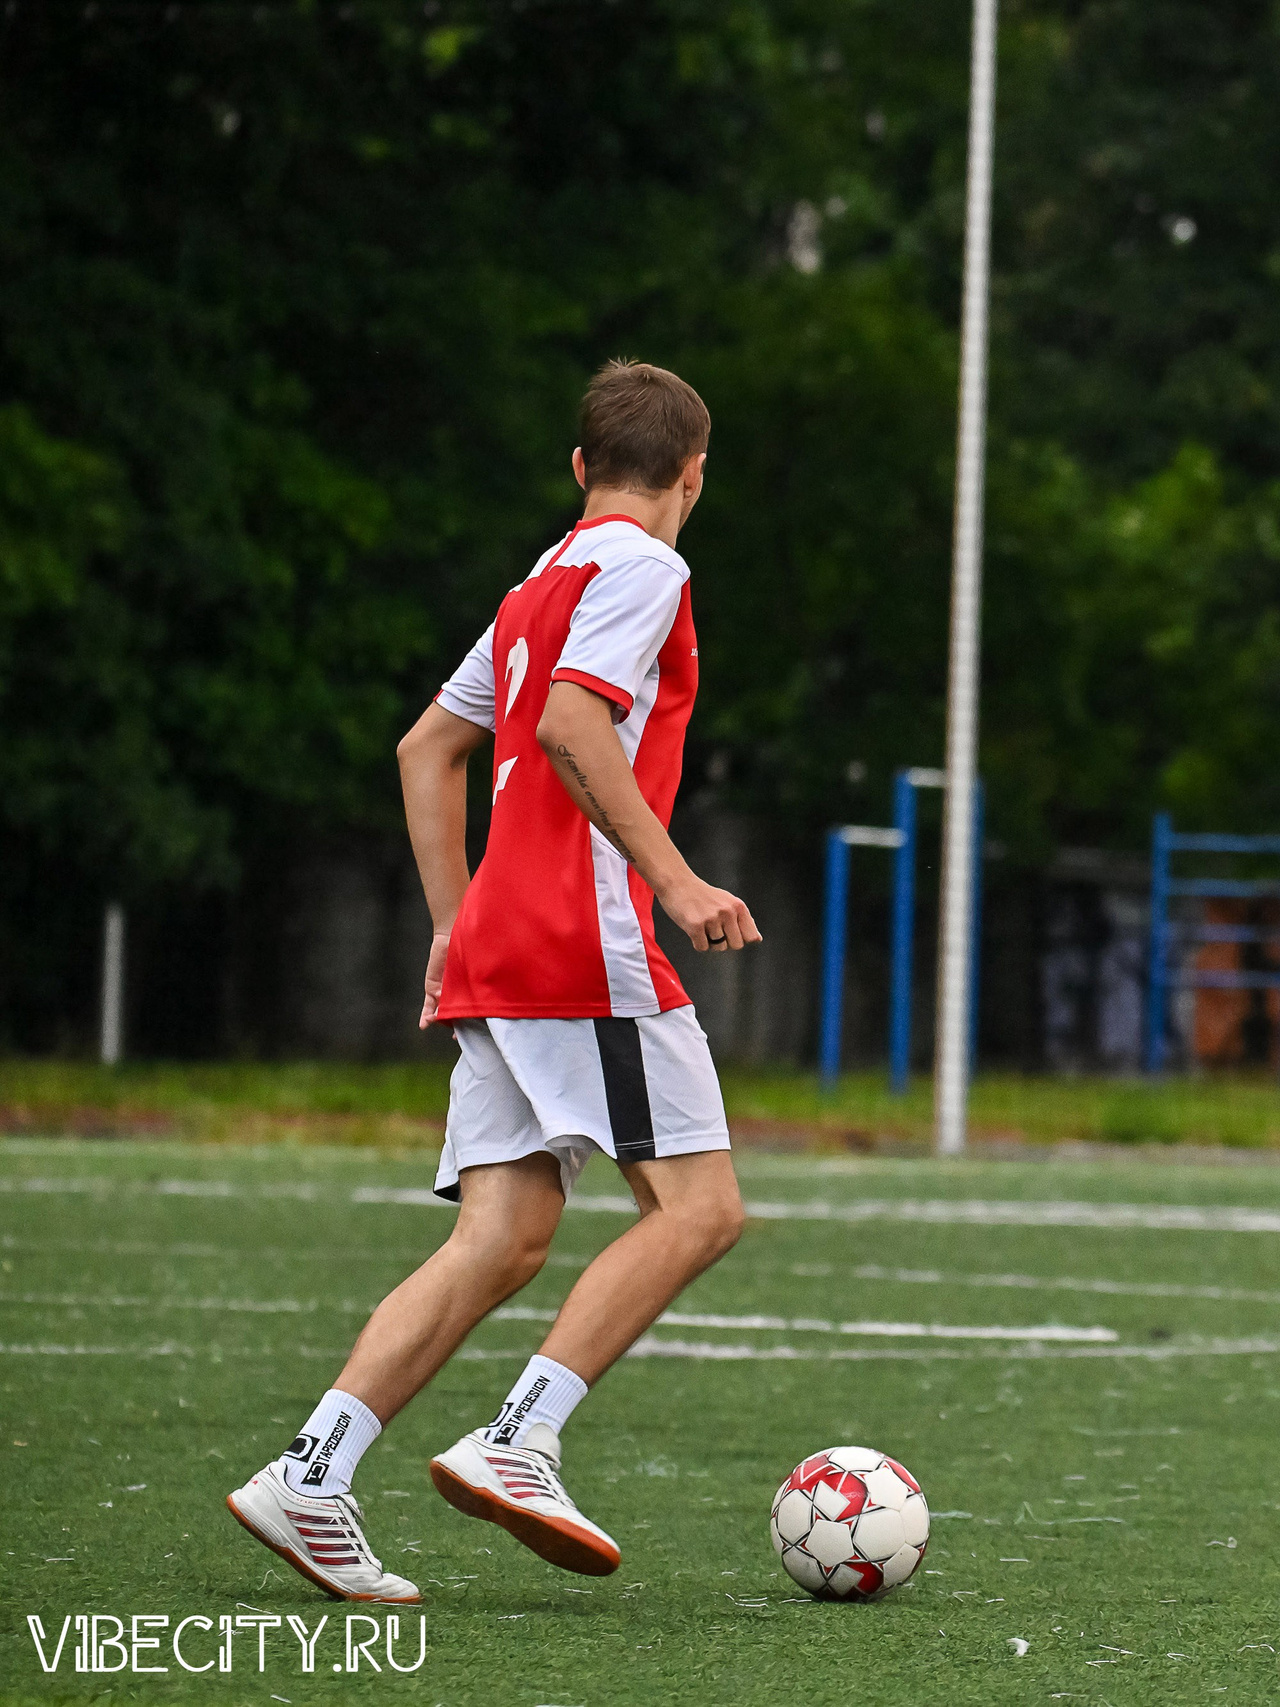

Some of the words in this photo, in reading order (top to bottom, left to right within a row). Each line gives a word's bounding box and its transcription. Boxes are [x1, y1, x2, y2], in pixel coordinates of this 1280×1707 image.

[557, 744, 589, 789] Familia
[507, 1375, 551, 1424] TAPEDESIGN
[316, 1411, 352, 1462] TAPEDESIGN
